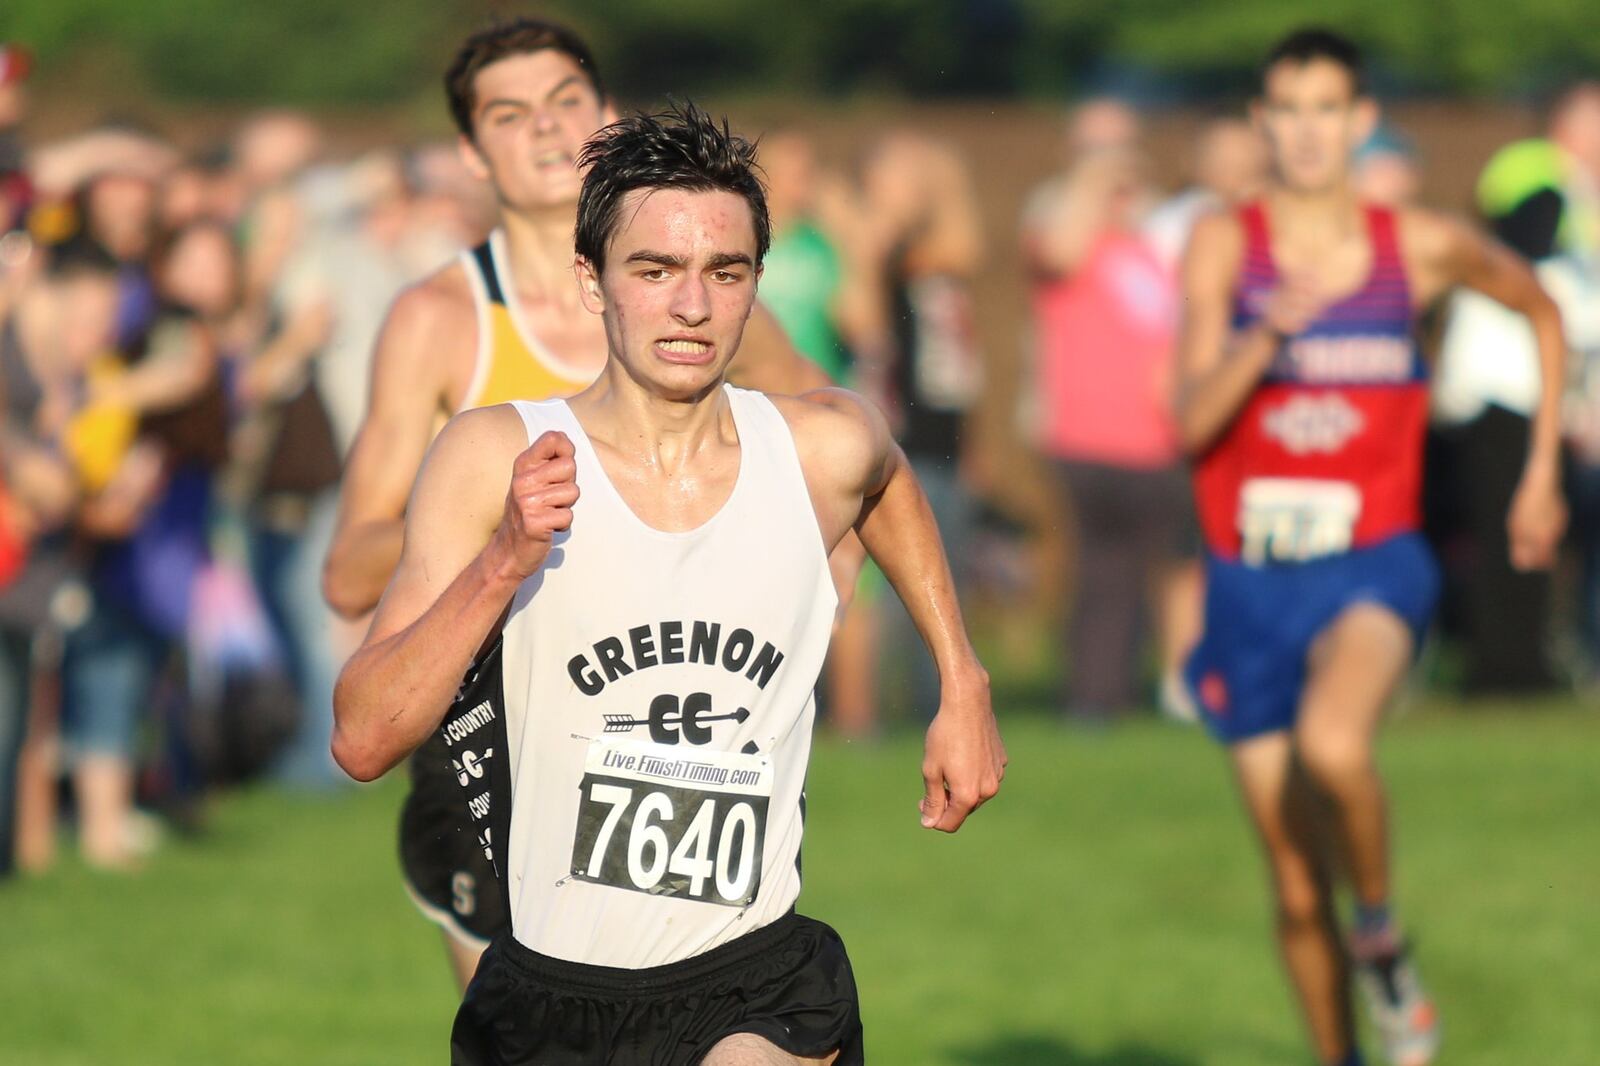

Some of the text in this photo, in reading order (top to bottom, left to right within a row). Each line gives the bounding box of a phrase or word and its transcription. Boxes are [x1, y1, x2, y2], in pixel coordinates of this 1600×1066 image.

[567, 620, 785, 697] GREENON
[447, 700, 496, 742] COUNTRY
[648, 692, 712, 746] CC
[602, 749, 761, 786] Live.FinishTiming.com
[586, 783, 757, 902] 7640
